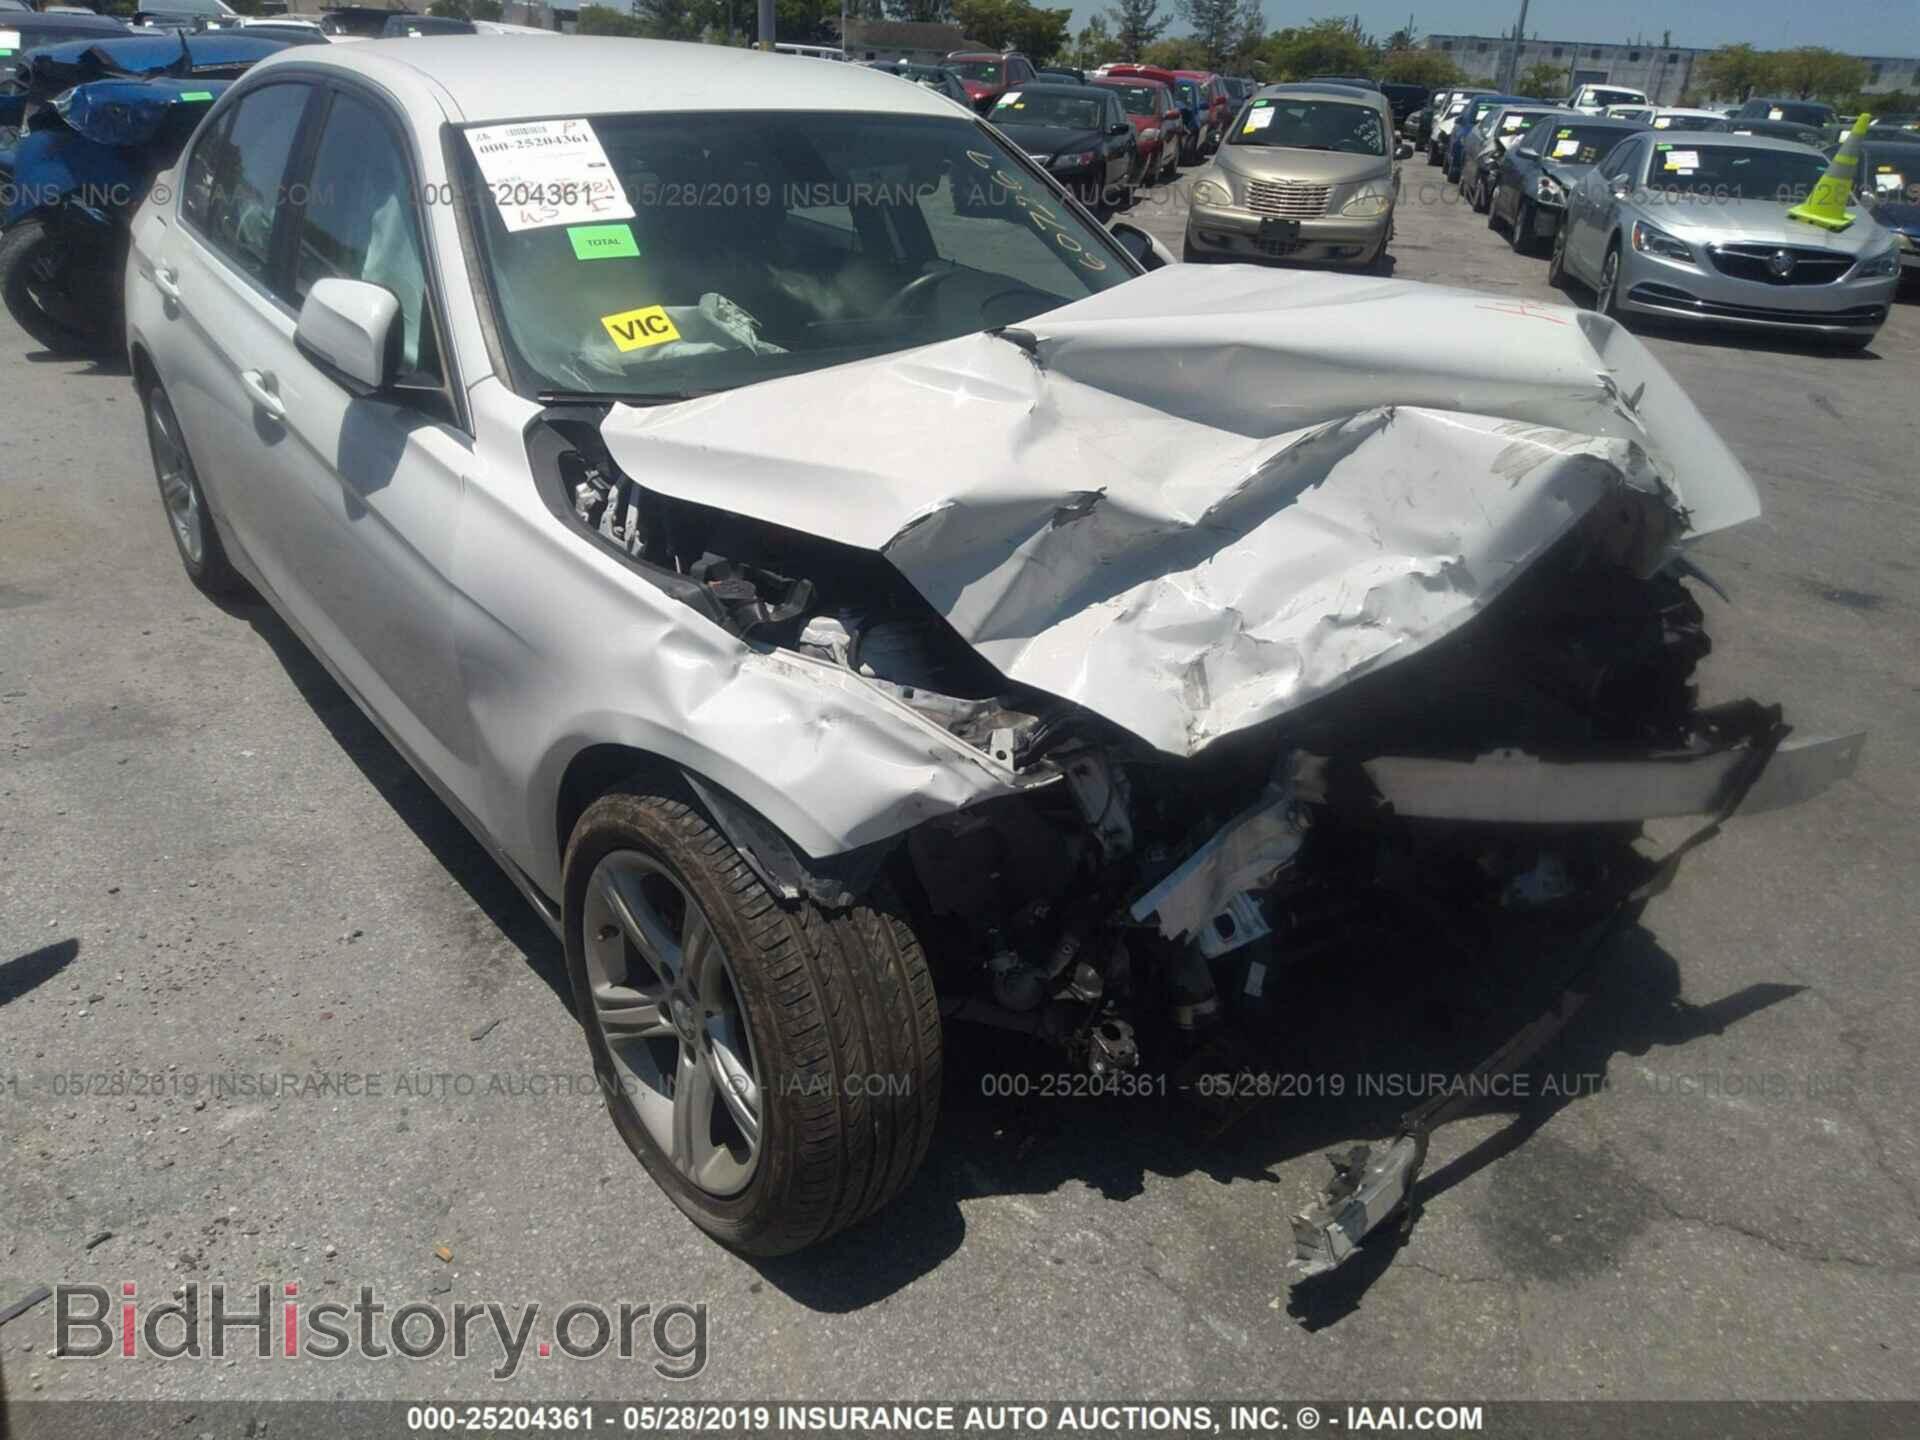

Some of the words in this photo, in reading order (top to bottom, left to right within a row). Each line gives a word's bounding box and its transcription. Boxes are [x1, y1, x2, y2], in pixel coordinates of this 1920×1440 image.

[480, 134, 590, 154] 000-25204361
[587, 238, 621, 247] TOTAL
[611, 315, 669, 341] VIC
